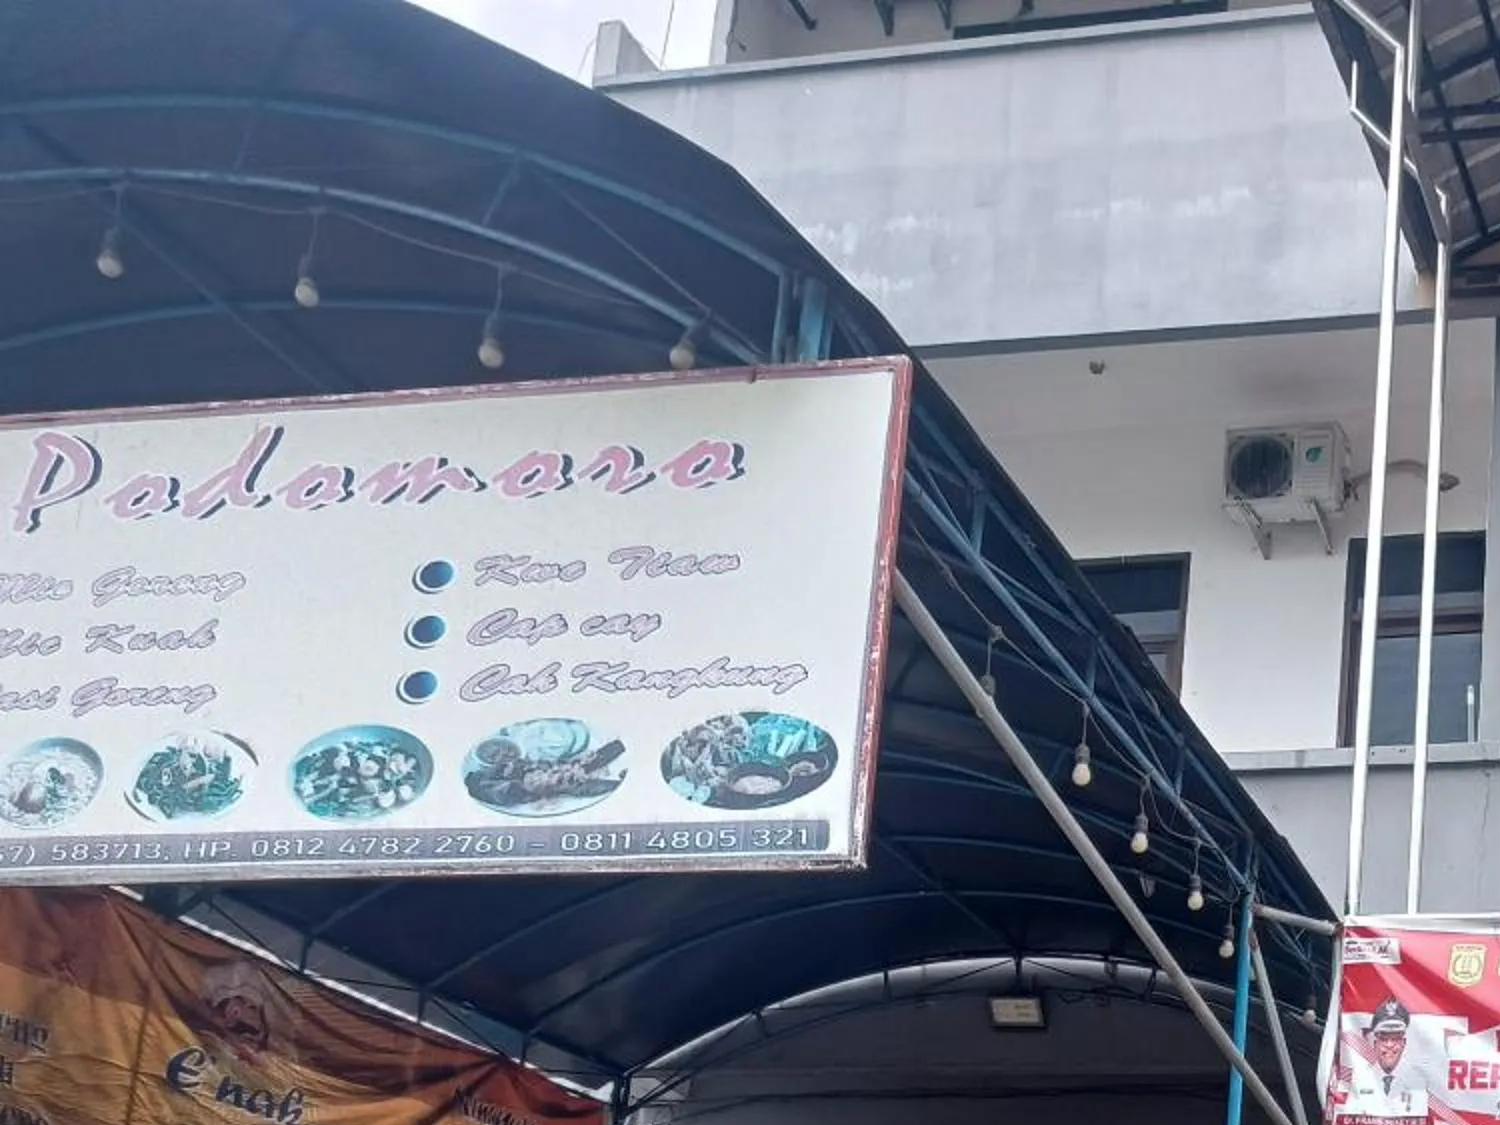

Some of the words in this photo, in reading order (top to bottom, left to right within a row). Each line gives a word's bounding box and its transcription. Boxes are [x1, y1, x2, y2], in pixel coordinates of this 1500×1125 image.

[92, 566, 247, 608] Goreng
[467, 608, 568, 646] Cap
[580, 613, 661, 642] cay
[0, 683, 60, 712] asi
[71, 676, 218, 718] Goreng
[571, 657, 808, 698] Kangkung
[51, 842, 170, 862] 583713.
[184, 840, 237, 858] HP.
[251, 839, 325, 857] 0812
[338, 837, 420, 856] 4782
[434, 835, 515, 854] 2760
[561, 832, 632, 852] 0811
[646, 829, 737, 850] 4805
[752, 828, 809, 847] 321
